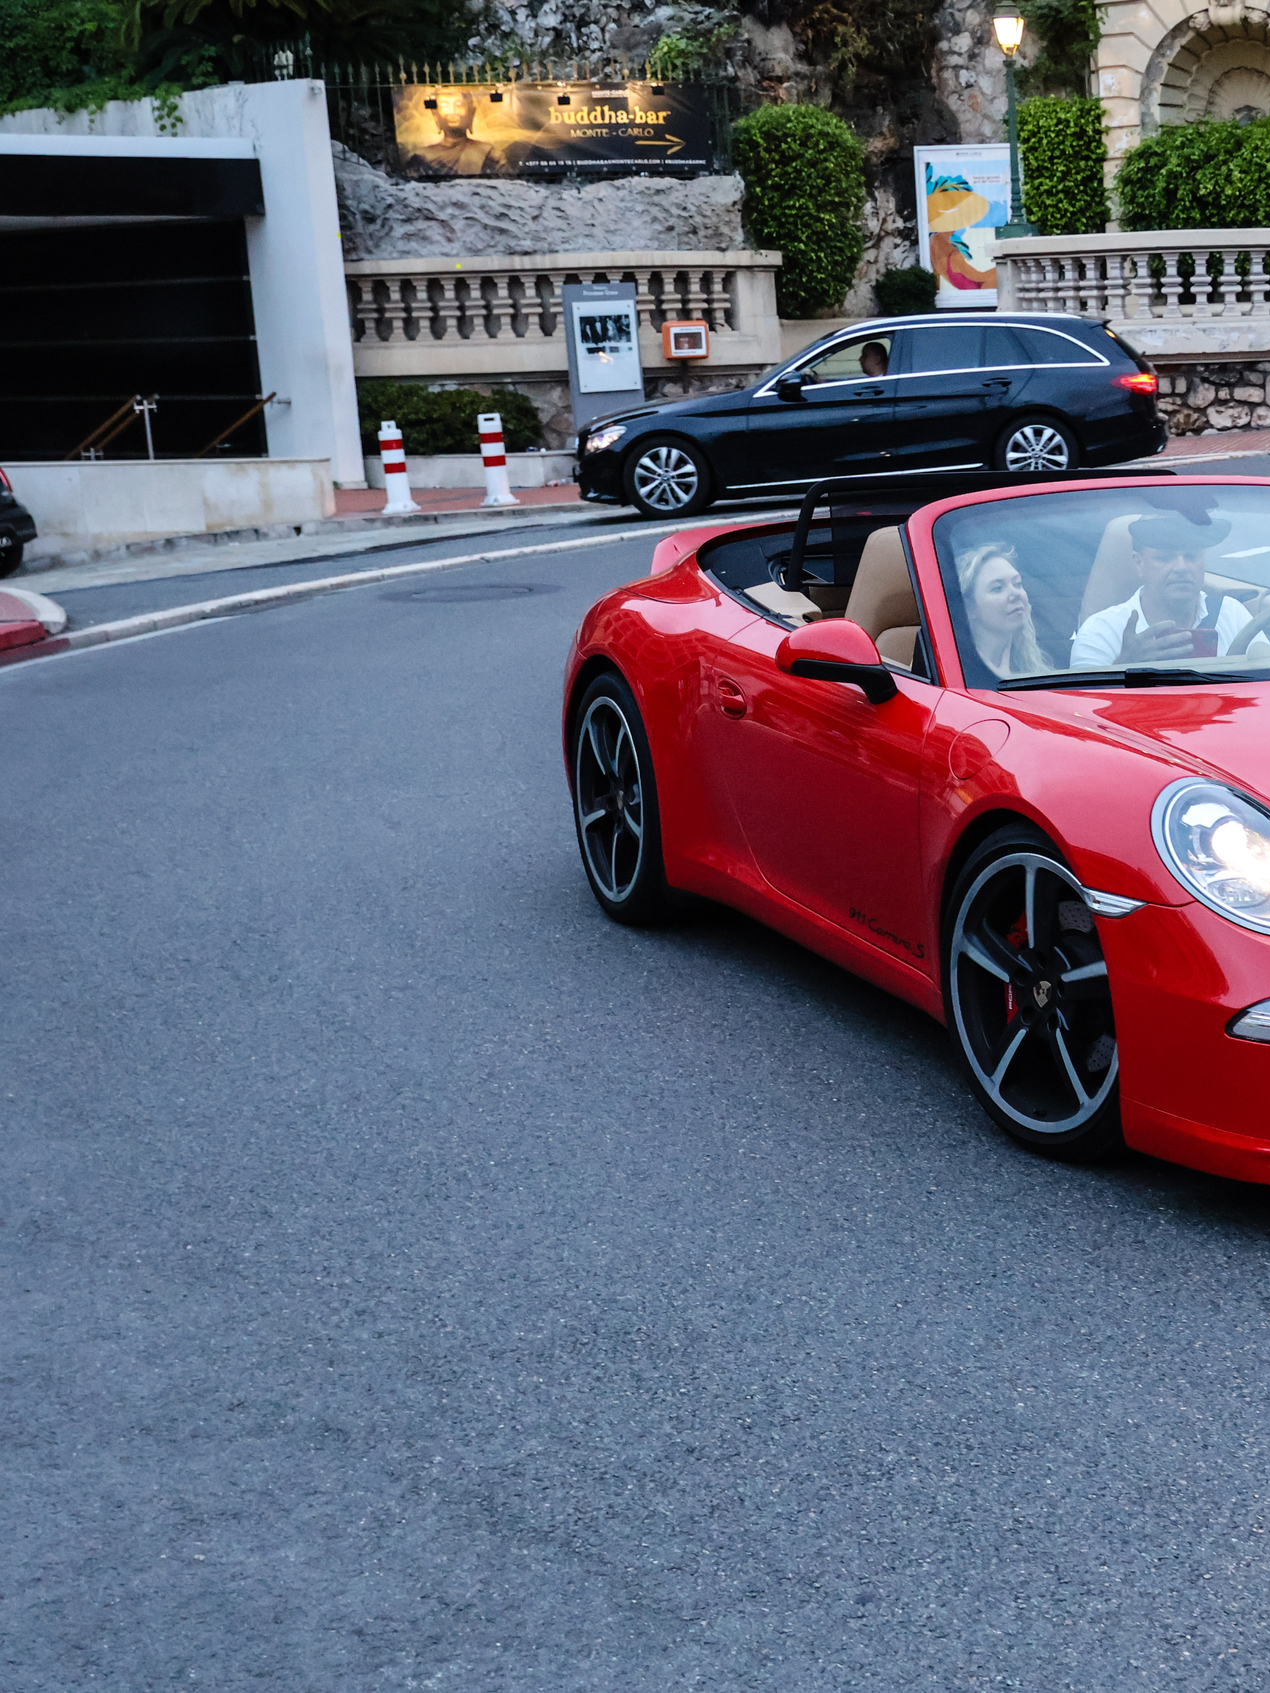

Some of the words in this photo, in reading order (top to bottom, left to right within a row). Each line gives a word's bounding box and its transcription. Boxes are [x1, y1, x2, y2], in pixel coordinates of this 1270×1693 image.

[548, 105, 668, 124] buddha-bar
[570, 128, 610, 138] MONTE
[618, 128, 654, 137] CARLO
